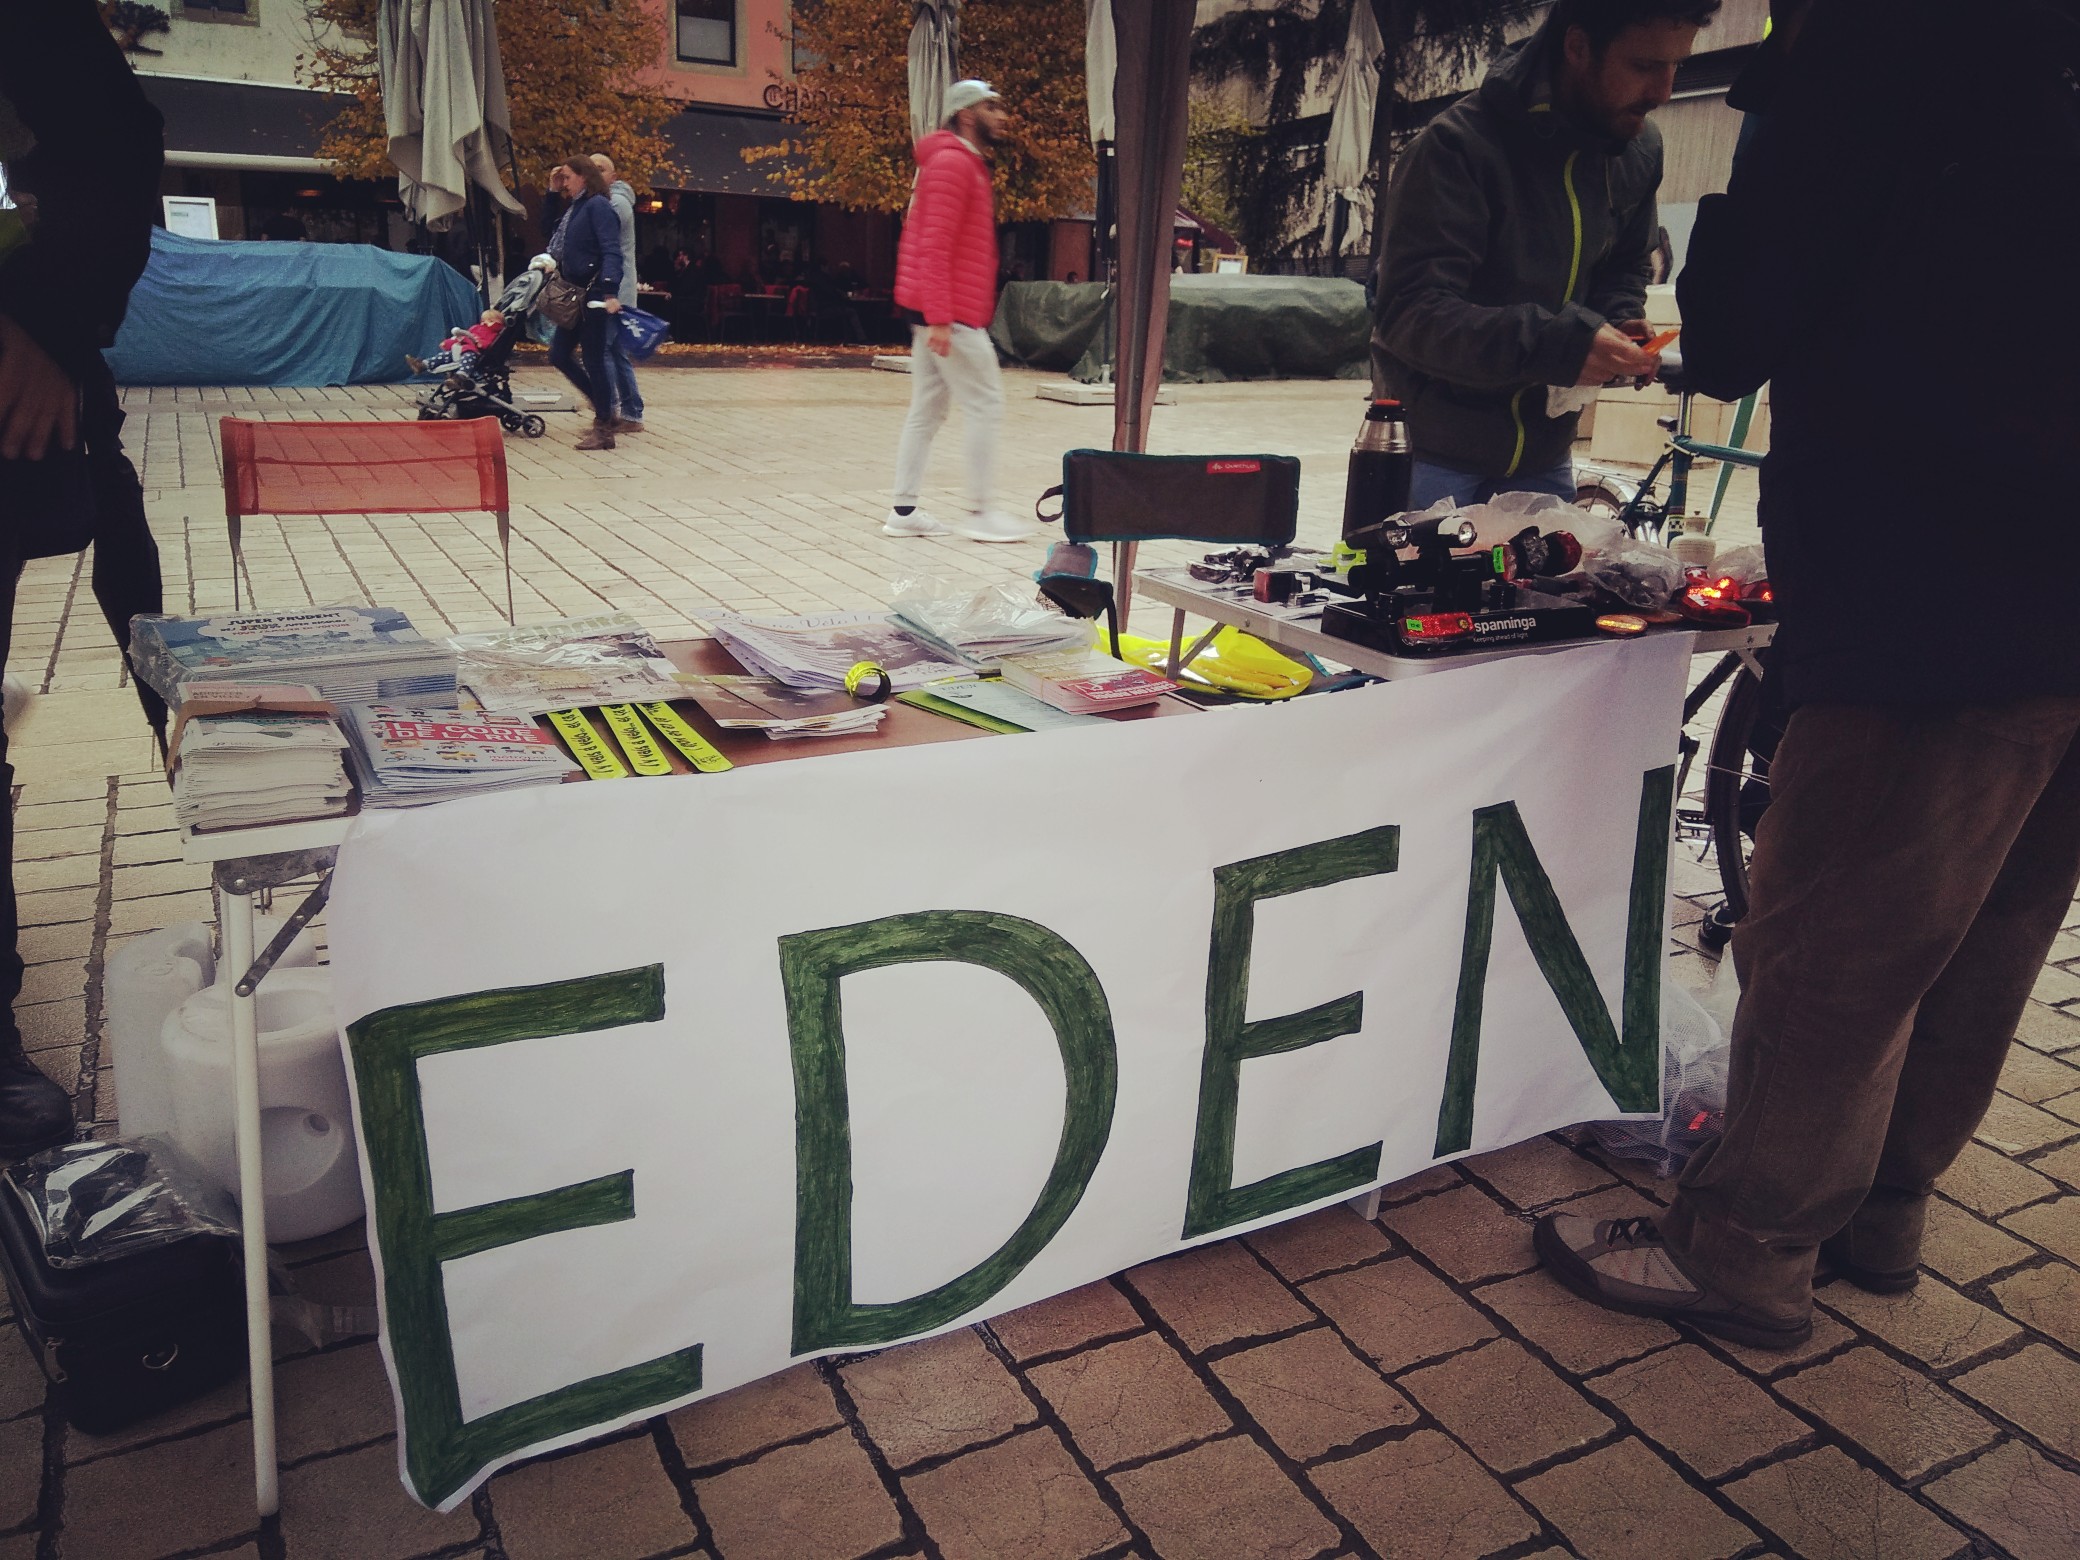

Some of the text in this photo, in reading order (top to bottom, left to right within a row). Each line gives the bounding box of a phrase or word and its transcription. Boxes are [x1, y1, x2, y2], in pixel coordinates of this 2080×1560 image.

[228, 618, 272, 626] SUPER
[277, 612, 341, 622] PRUDENT
[1474, 616, 1537, 634] spanninga
[394, 723, 531, 736] LE CODE
[442, 731, 478, 740] LA
[486, 733, 541, 742] RUE
[346, 764, 1675, 1510] EDEN
